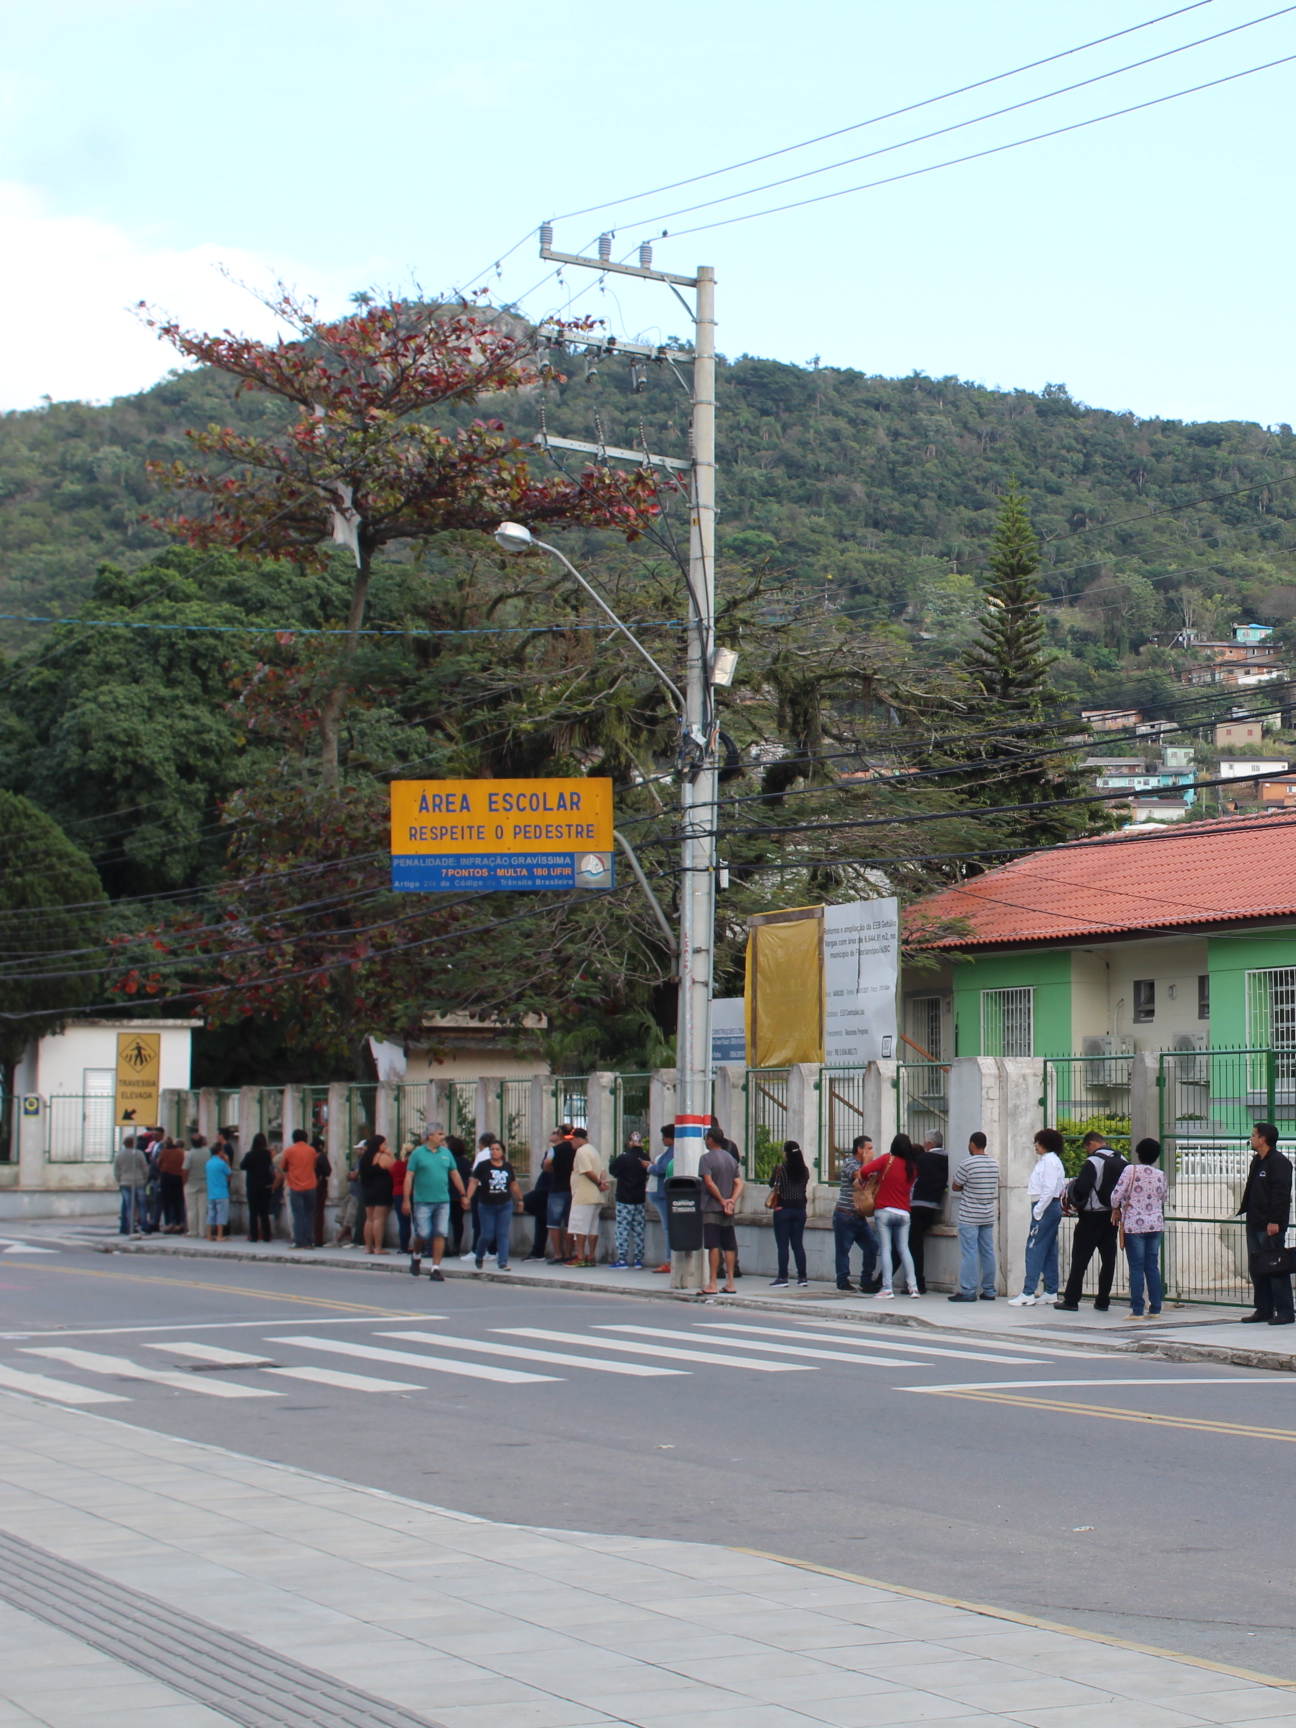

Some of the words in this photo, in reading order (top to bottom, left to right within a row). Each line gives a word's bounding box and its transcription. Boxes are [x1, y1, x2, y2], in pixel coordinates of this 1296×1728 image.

[418, 789, 471, 813] ÁREA
[488, 791, 582, 812] ESCOLAR
[409, 825, 486, 841] RESPEITE
[495, 824, 504, 840] O
[513, 824, 595, 840] PEDESTRE
[393, 856, 458, 867] PENALIDADE:
[460, 856, 510, 867] INFRAÇÃO
[510, 854, 572, 865] GRAVÍSSIMA
[441, 868, 448, 877] 7
[448, 868, 488, 877] PONTOS
[496, 868, 528, 877] MULTA
[532, 868, 548, 876] 180
[550, 867, 573, 876] UFIR
[394, 880, 420, 888] Artigo
[440, 880, 450, 888] do
[454, 878, 484, 888] Código
[500, 878, 533, 886] Trânsito
[535, 878, 574, 886] Brasileiro
